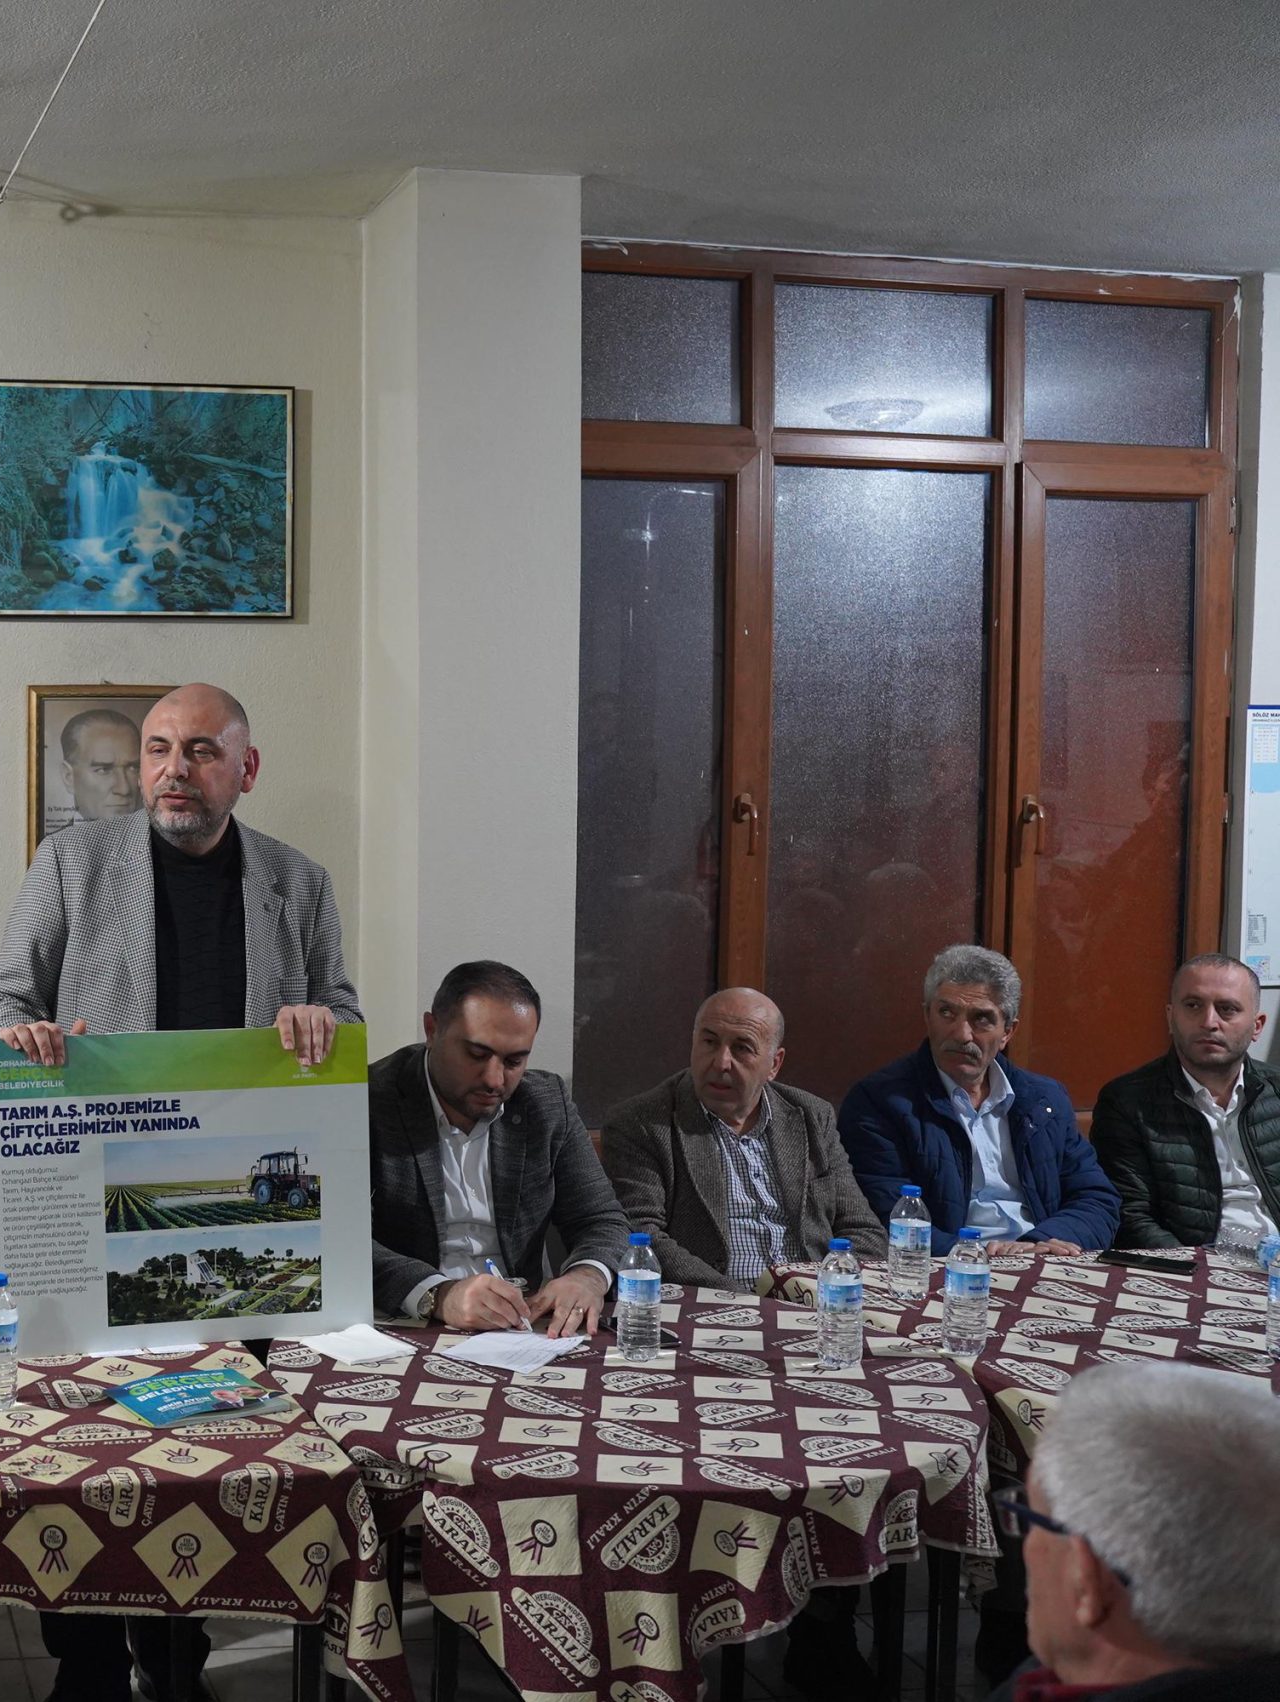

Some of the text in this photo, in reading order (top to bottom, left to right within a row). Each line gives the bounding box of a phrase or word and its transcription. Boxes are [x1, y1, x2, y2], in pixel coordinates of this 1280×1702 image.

[0, 1098, 181, 1121] TARIM A.Ş. PROJEMİZLE
[0, 1116, 200, 1140] ÇİFTÇİLERİMİZİN YANINDA
[0, 1138, 80, 1158] OLACAĞIZ
[2, 1177, 32, 1185] Orhangazi
[33, 1176, 52, 1184] Bahçe
[21, 1185, 54, 1194] Hayvancılık
[44, 1258, 84, 1267] Belediyemize
[425, 1502, 490, 1566] KARALİ
[611, 1502, 670, 1564] KARALİ
[520, 1596, 592, 1664] KARALİ
[503, 1603, 540, 1644] ÇAYIN
[540, 1646, 584, 1688] KRALI
